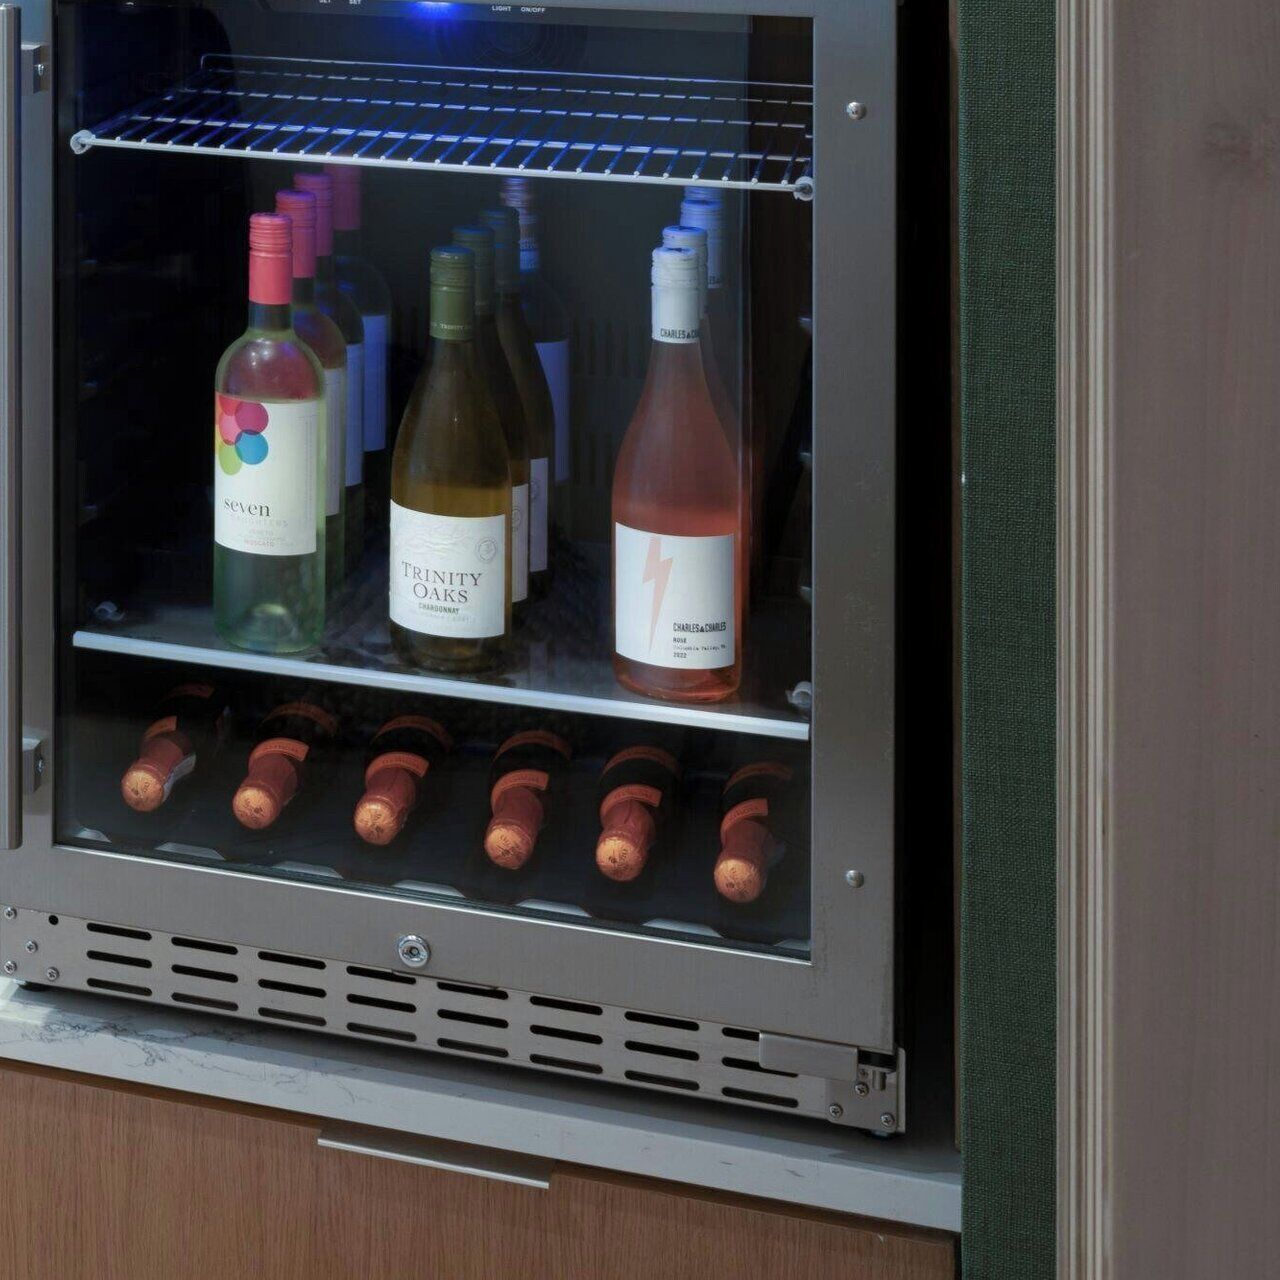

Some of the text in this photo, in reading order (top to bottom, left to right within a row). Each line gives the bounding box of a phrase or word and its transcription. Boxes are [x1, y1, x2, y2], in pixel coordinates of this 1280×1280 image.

[520, 6, 546, 14] ON/OFF
[224, 497, 271, 516] seven
[401, 561, 483, 587] TRINITY
[412, 582, 469, 604] OAKS
[418, 602, 460, 615] CHARDONNAY
